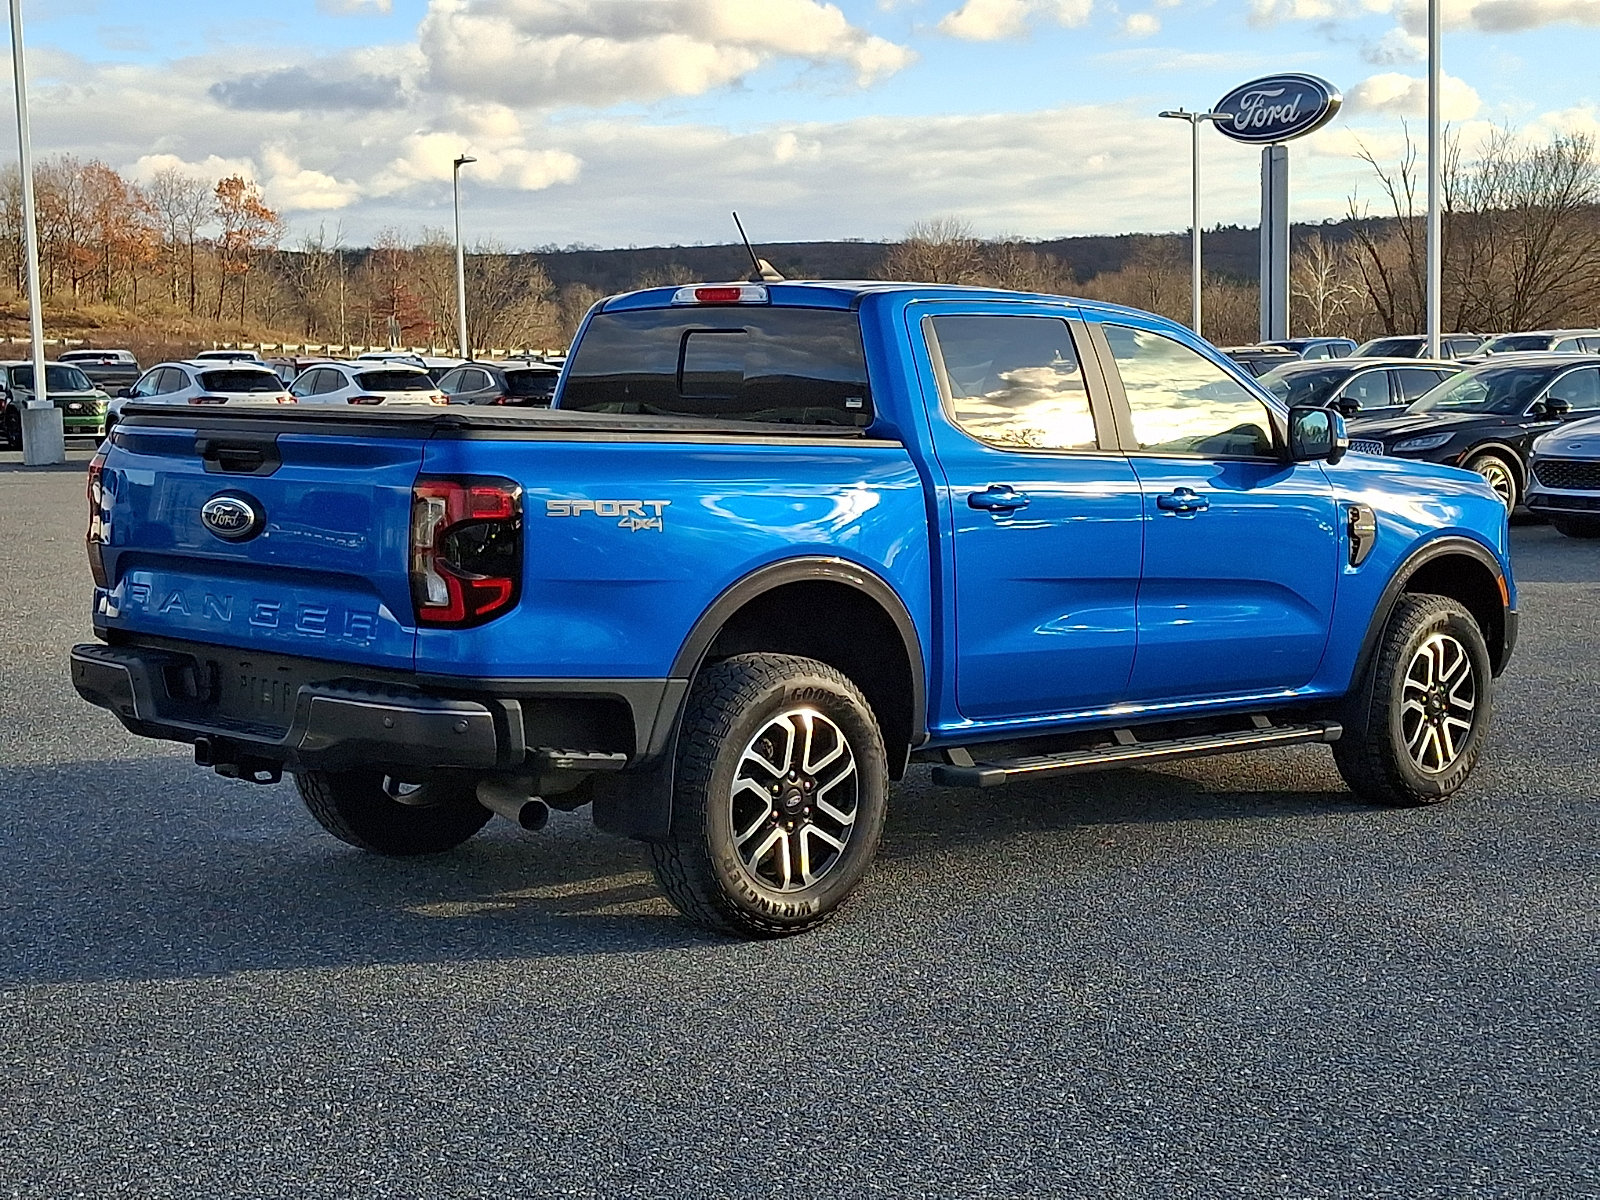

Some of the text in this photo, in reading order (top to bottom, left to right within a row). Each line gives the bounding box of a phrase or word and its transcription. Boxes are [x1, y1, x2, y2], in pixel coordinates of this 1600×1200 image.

[1234, 87, 1302, 131] Ford
[210, 504, 240, 527] Ford
[546, 499, 672, 517] SPORT
[125, 582, 379, 640] RANGER
